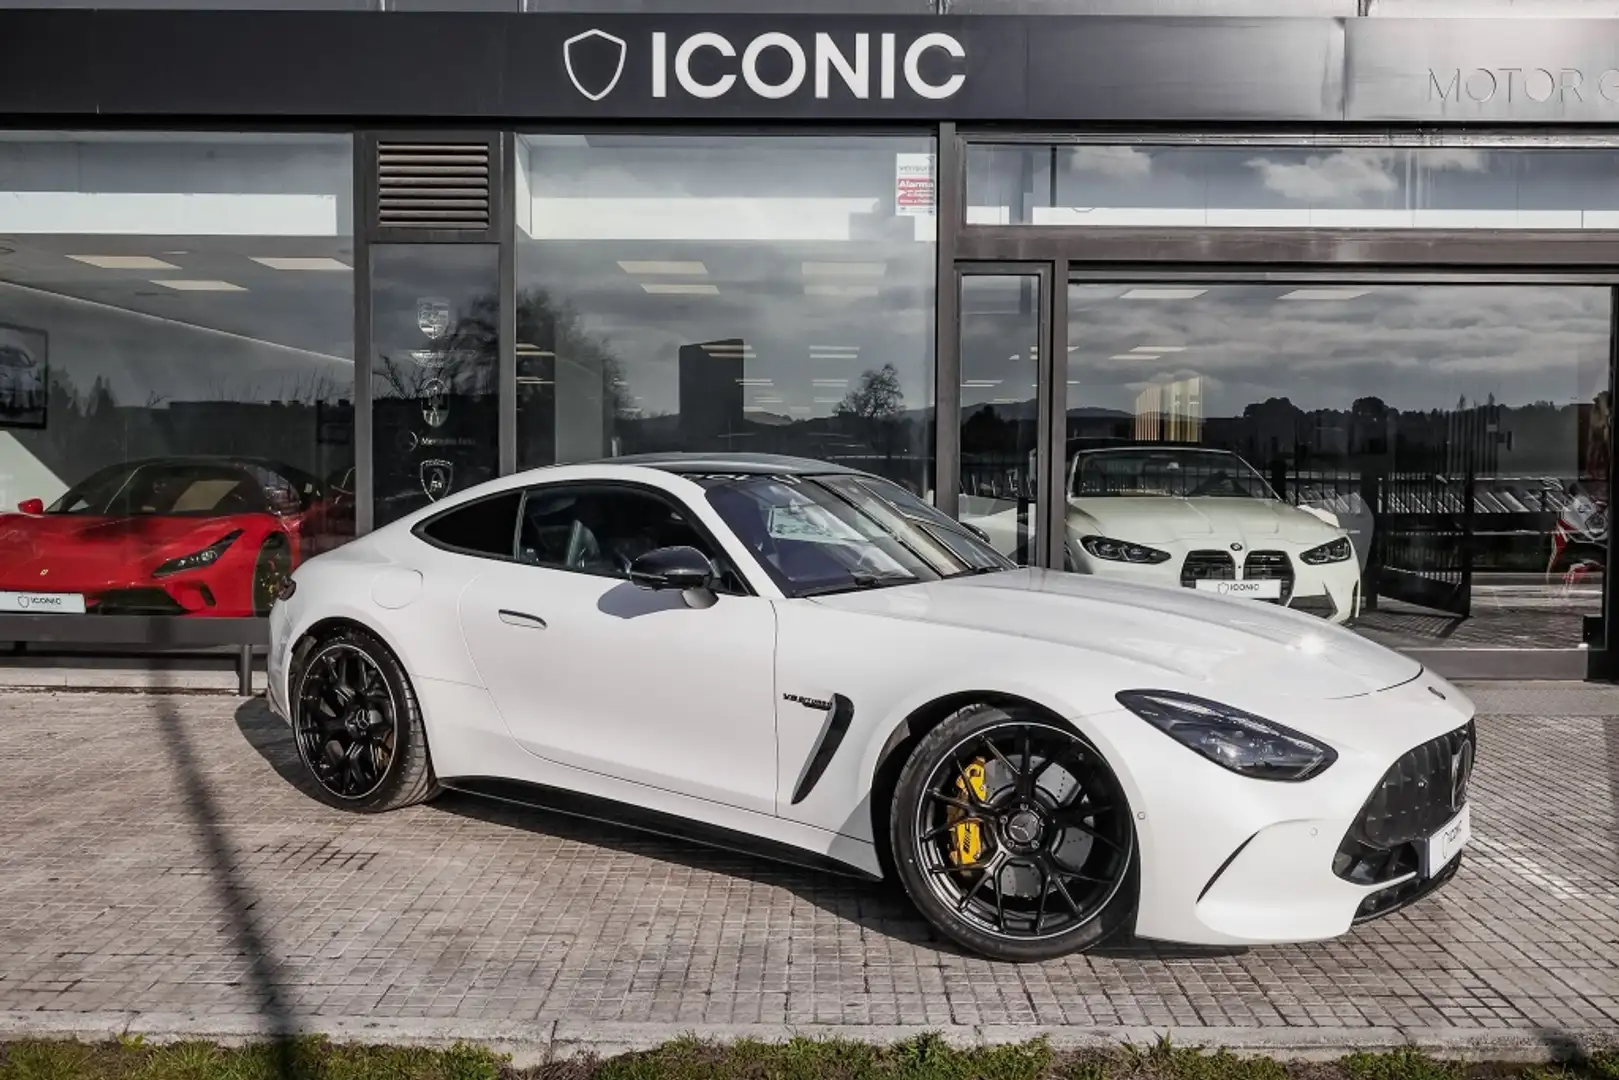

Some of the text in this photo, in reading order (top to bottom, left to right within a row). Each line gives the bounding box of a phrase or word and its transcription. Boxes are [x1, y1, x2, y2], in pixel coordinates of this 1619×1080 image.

[652, 31, 967, 100] ICONIC
[1427, 67, 1584, 103] MOTOR
[899, 180, 934, 188] Alarma
